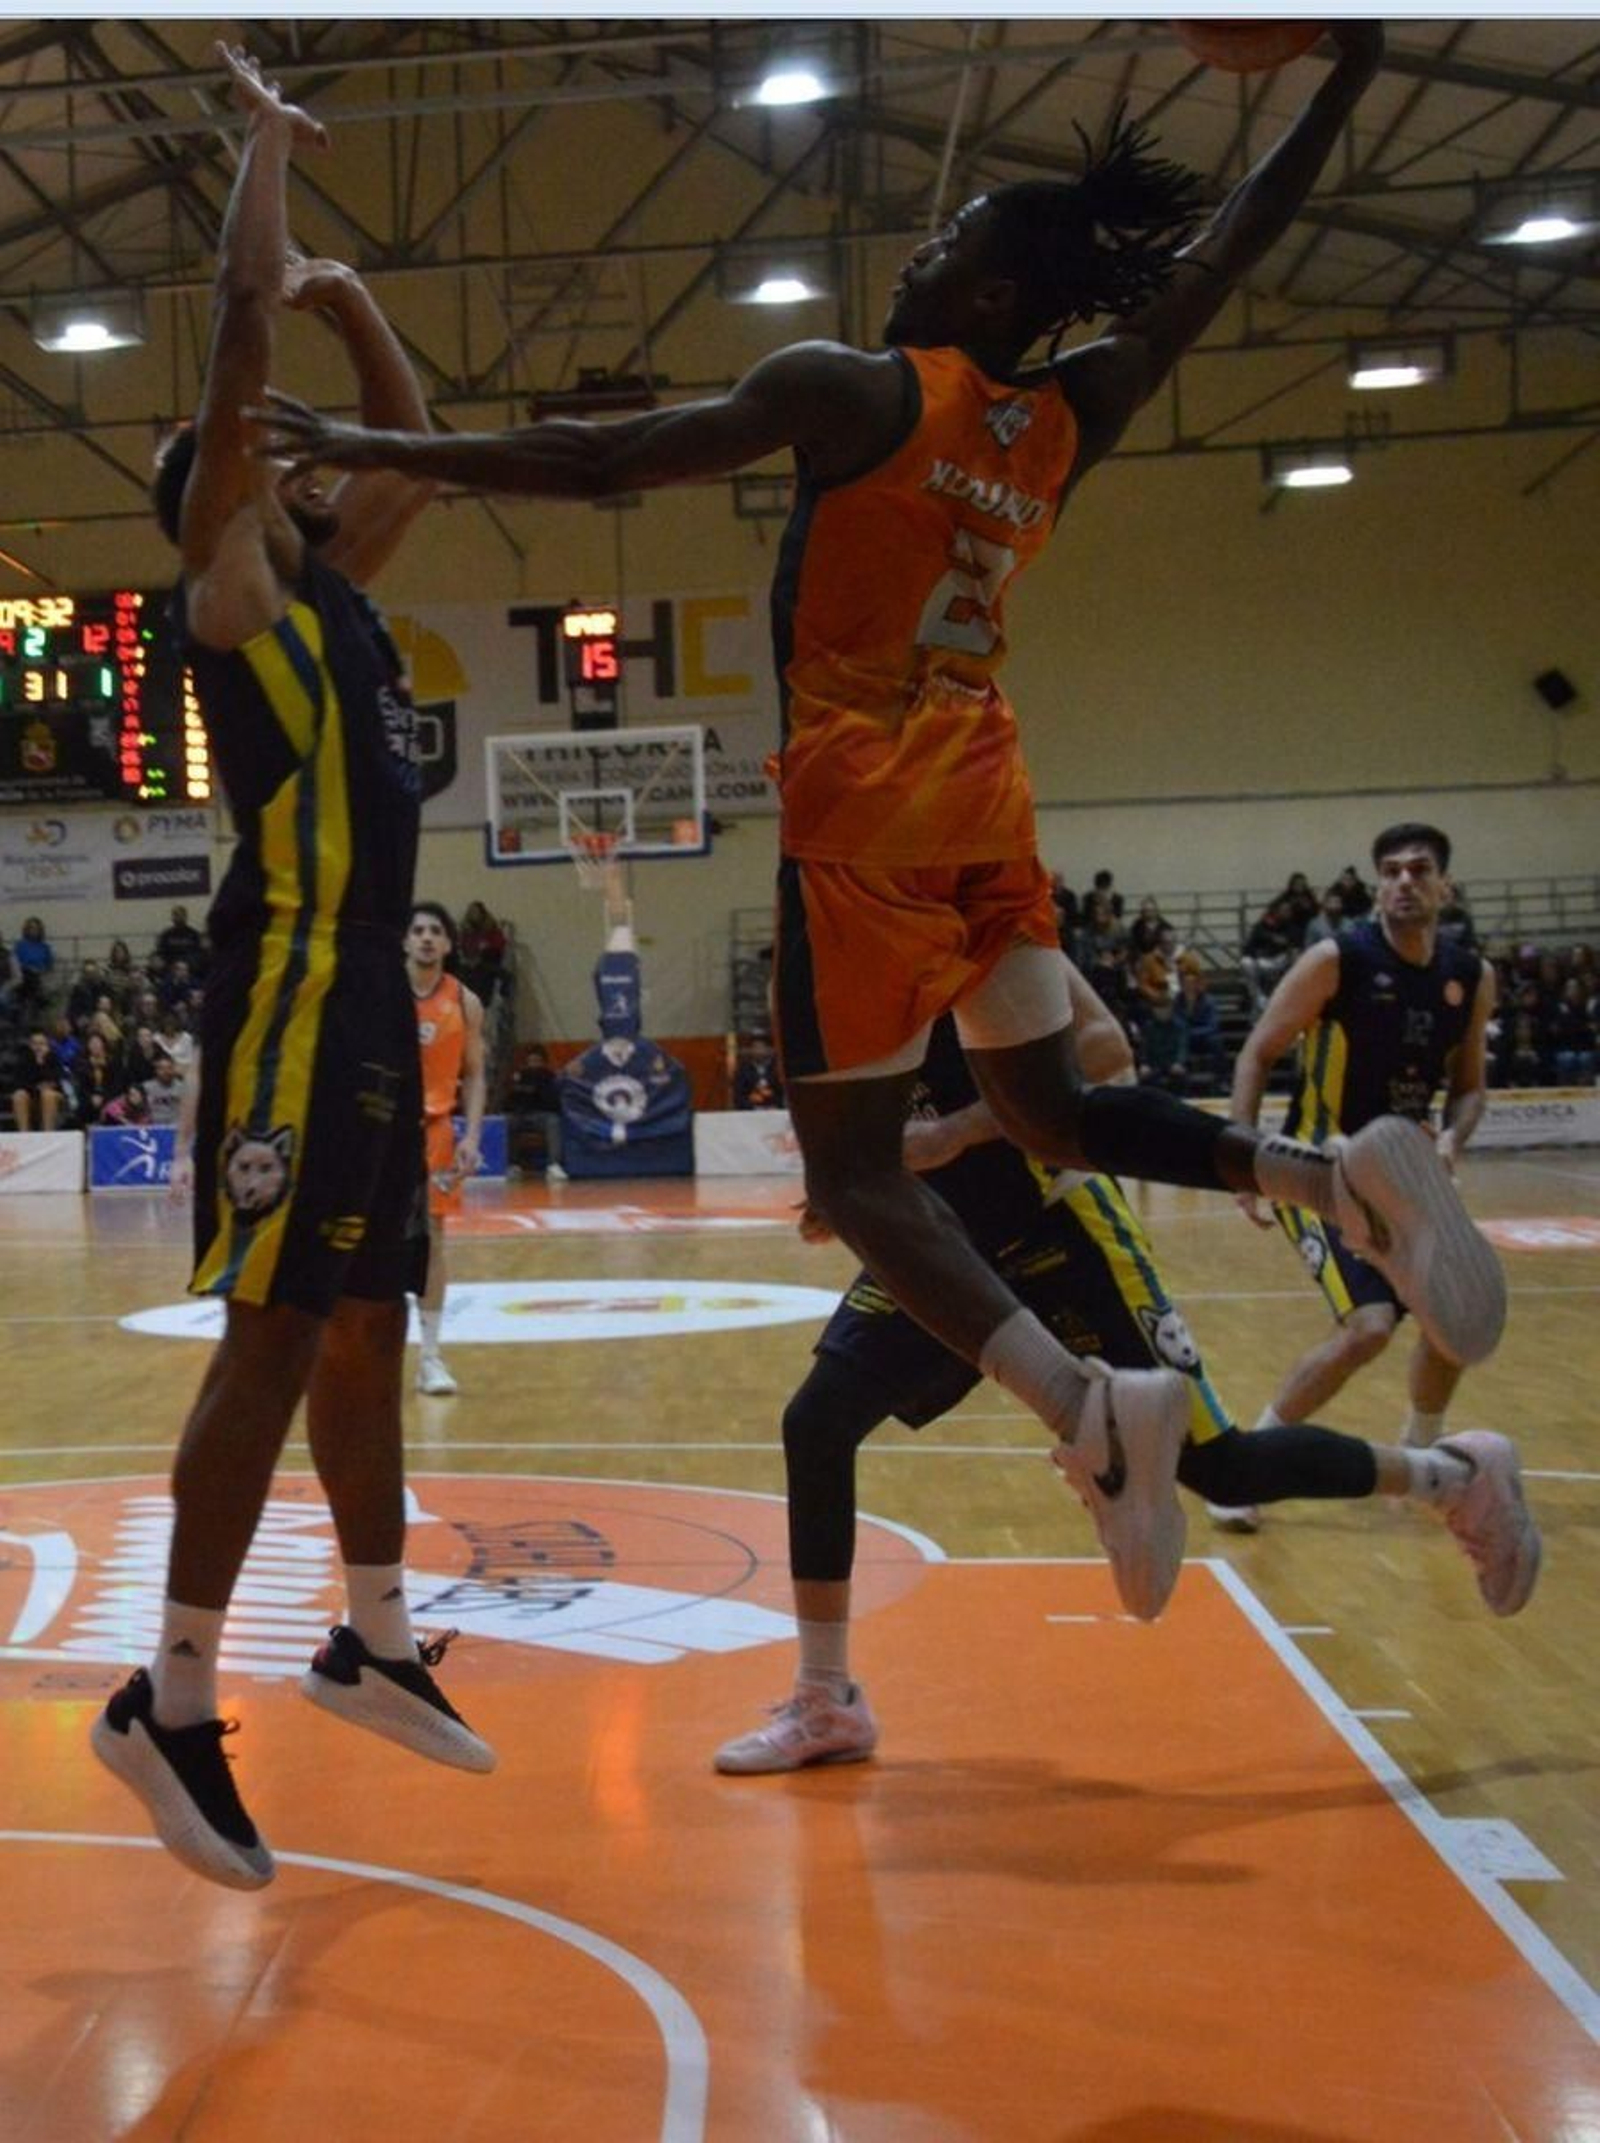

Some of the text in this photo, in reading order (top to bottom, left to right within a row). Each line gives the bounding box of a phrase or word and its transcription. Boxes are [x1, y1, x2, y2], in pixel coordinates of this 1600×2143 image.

[916, 530, 1015, 655] 2
[82, 625, 109, 653] 12
[508, 599, 752, 704] THC
[582, 641, 618, 680] 15
